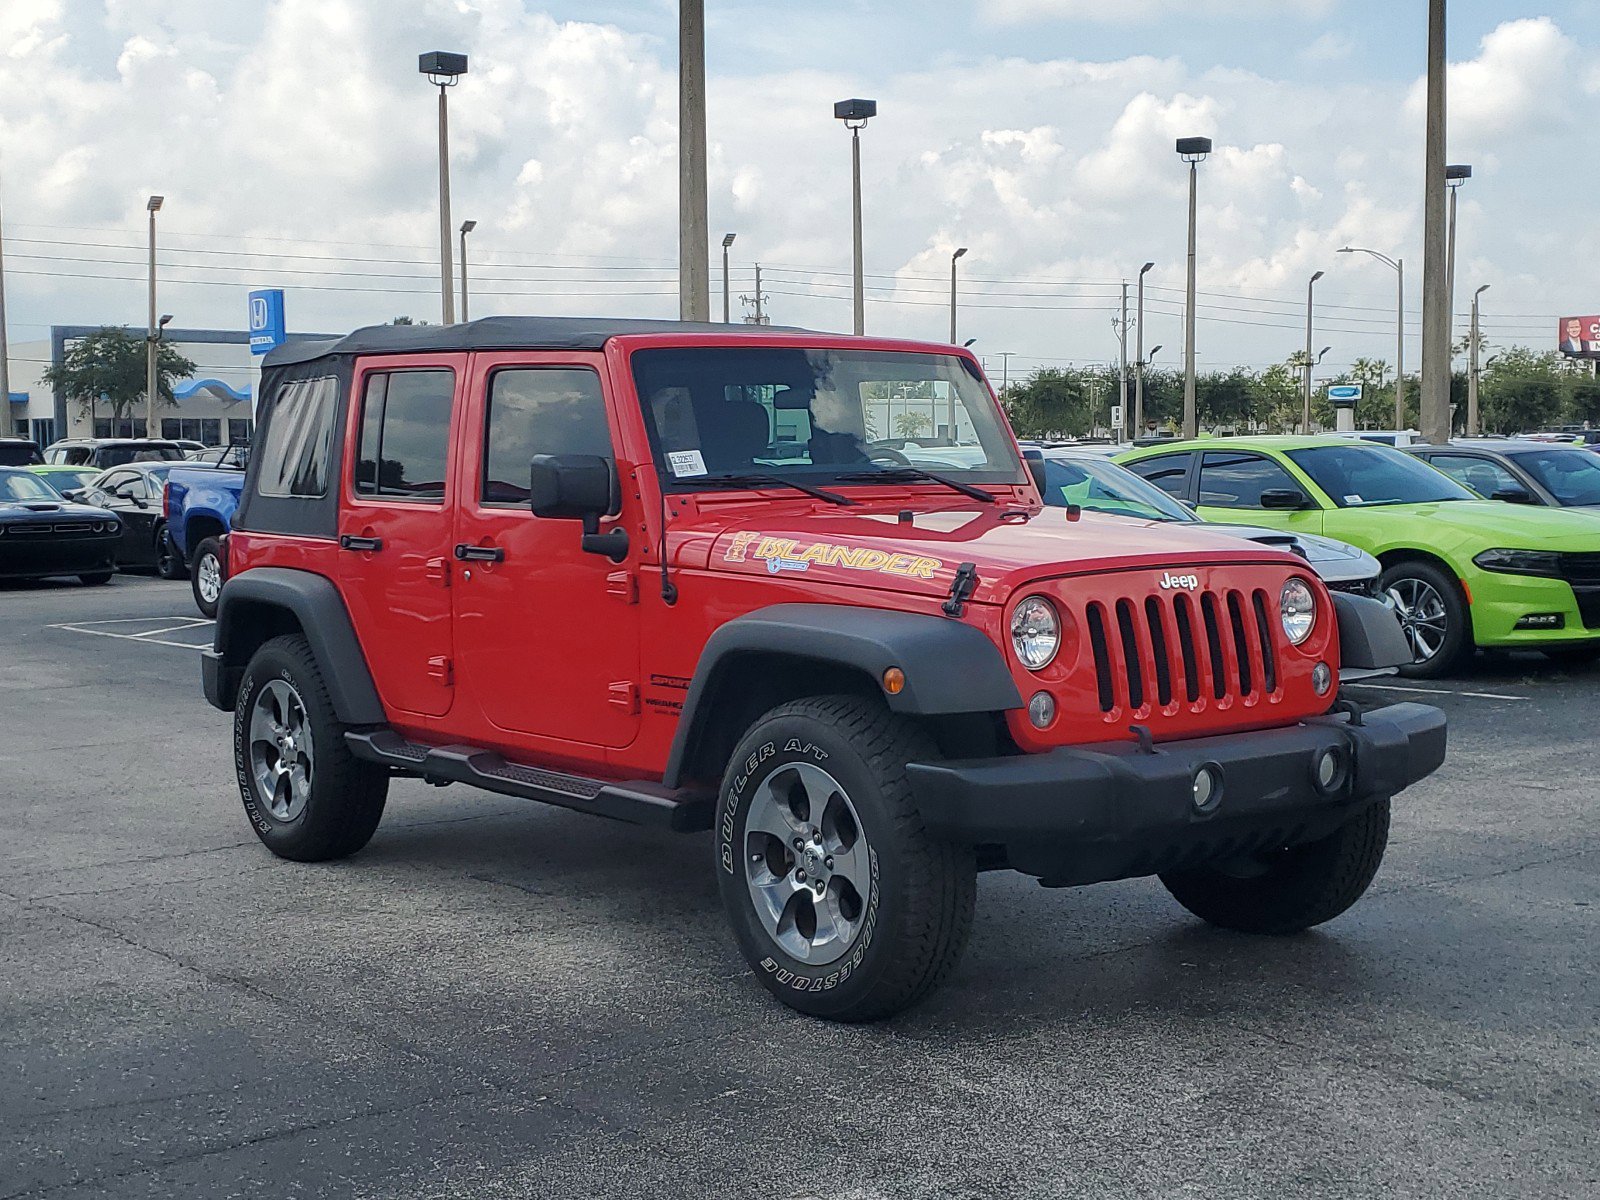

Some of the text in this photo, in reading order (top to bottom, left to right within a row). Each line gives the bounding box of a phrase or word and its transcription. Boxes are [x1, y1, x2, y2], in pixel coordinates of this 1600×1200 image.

[753, 537, 943, 578] ISLANDER
[1160, 572, 1199, 591] Jeep
[722, 738, 829, 874] DUELER A/T
[760, 844, 880, 992] BRIDGESTONE
